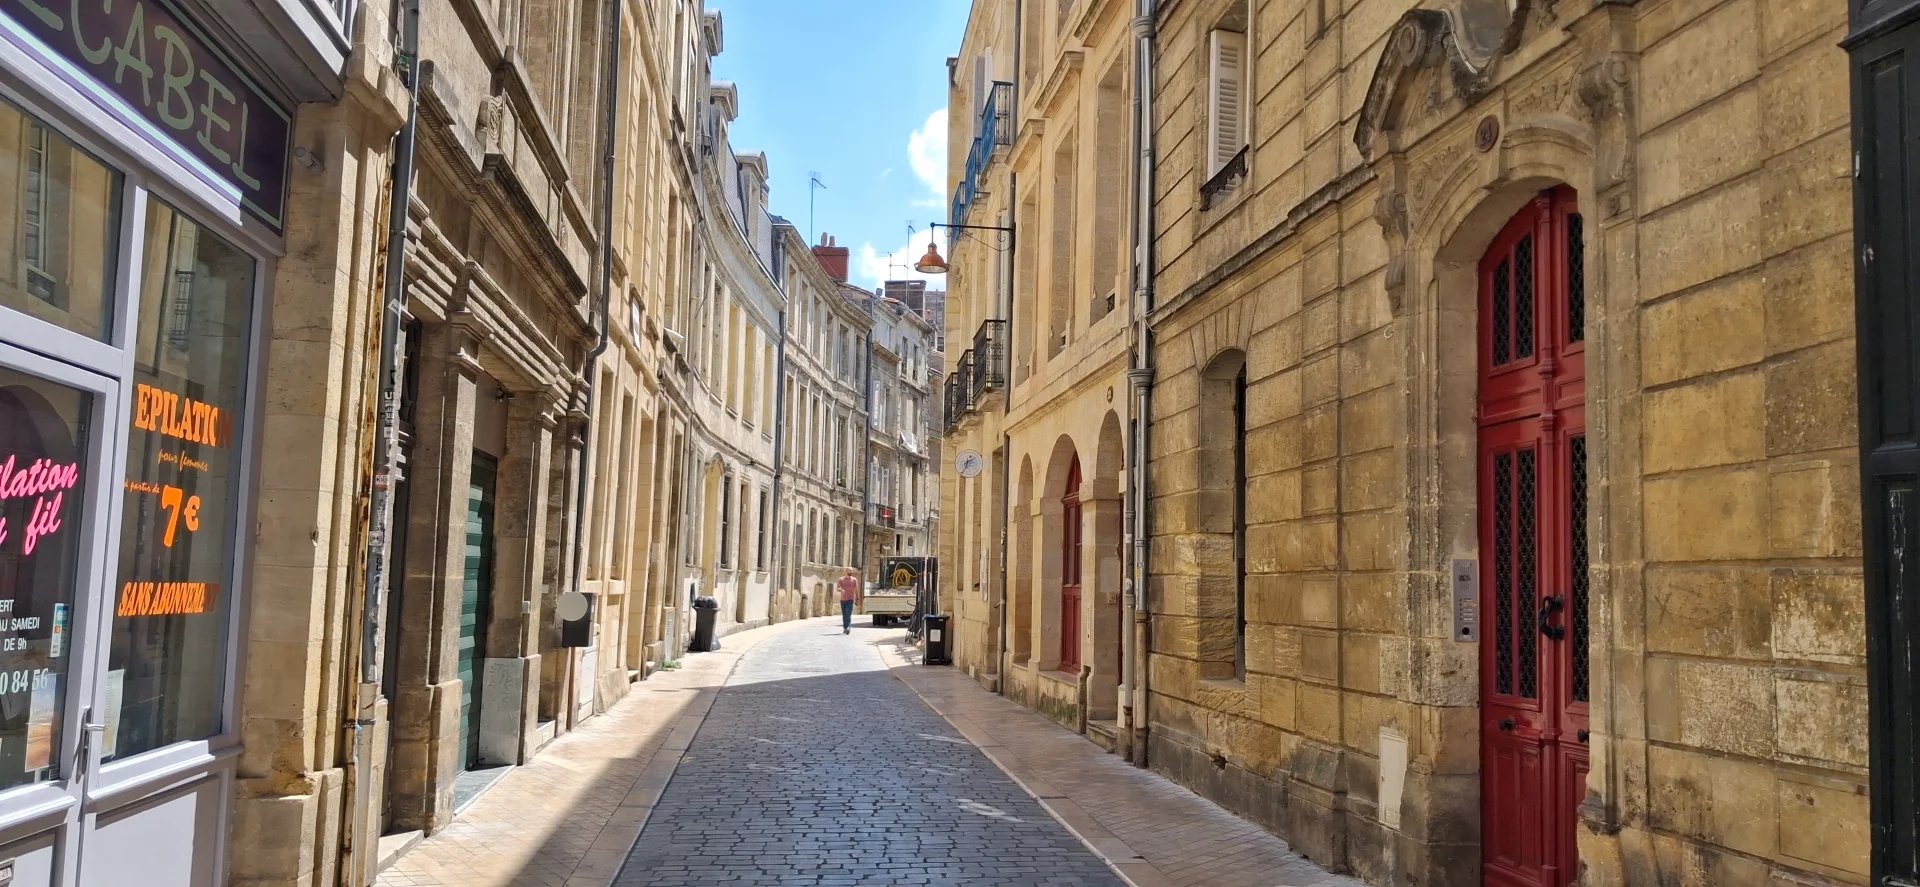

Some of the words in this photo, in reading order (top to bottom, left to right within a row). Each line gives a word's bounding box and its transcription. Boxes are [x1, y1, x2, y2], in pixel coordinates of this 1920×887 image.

[179, 450, 209, 472] femmes
[0, 454, 78, 500] lation
[24, 491, 63, 556] fil
[117, 581, 154, 617] SANS
[11, 616, 40, 631] SAMEDI
[4, 637, 16, 652] DE
[17, 636, 27, 650] 9h
[11, 669, 29, 694] 84
[32, 667, 49, 691] 56
